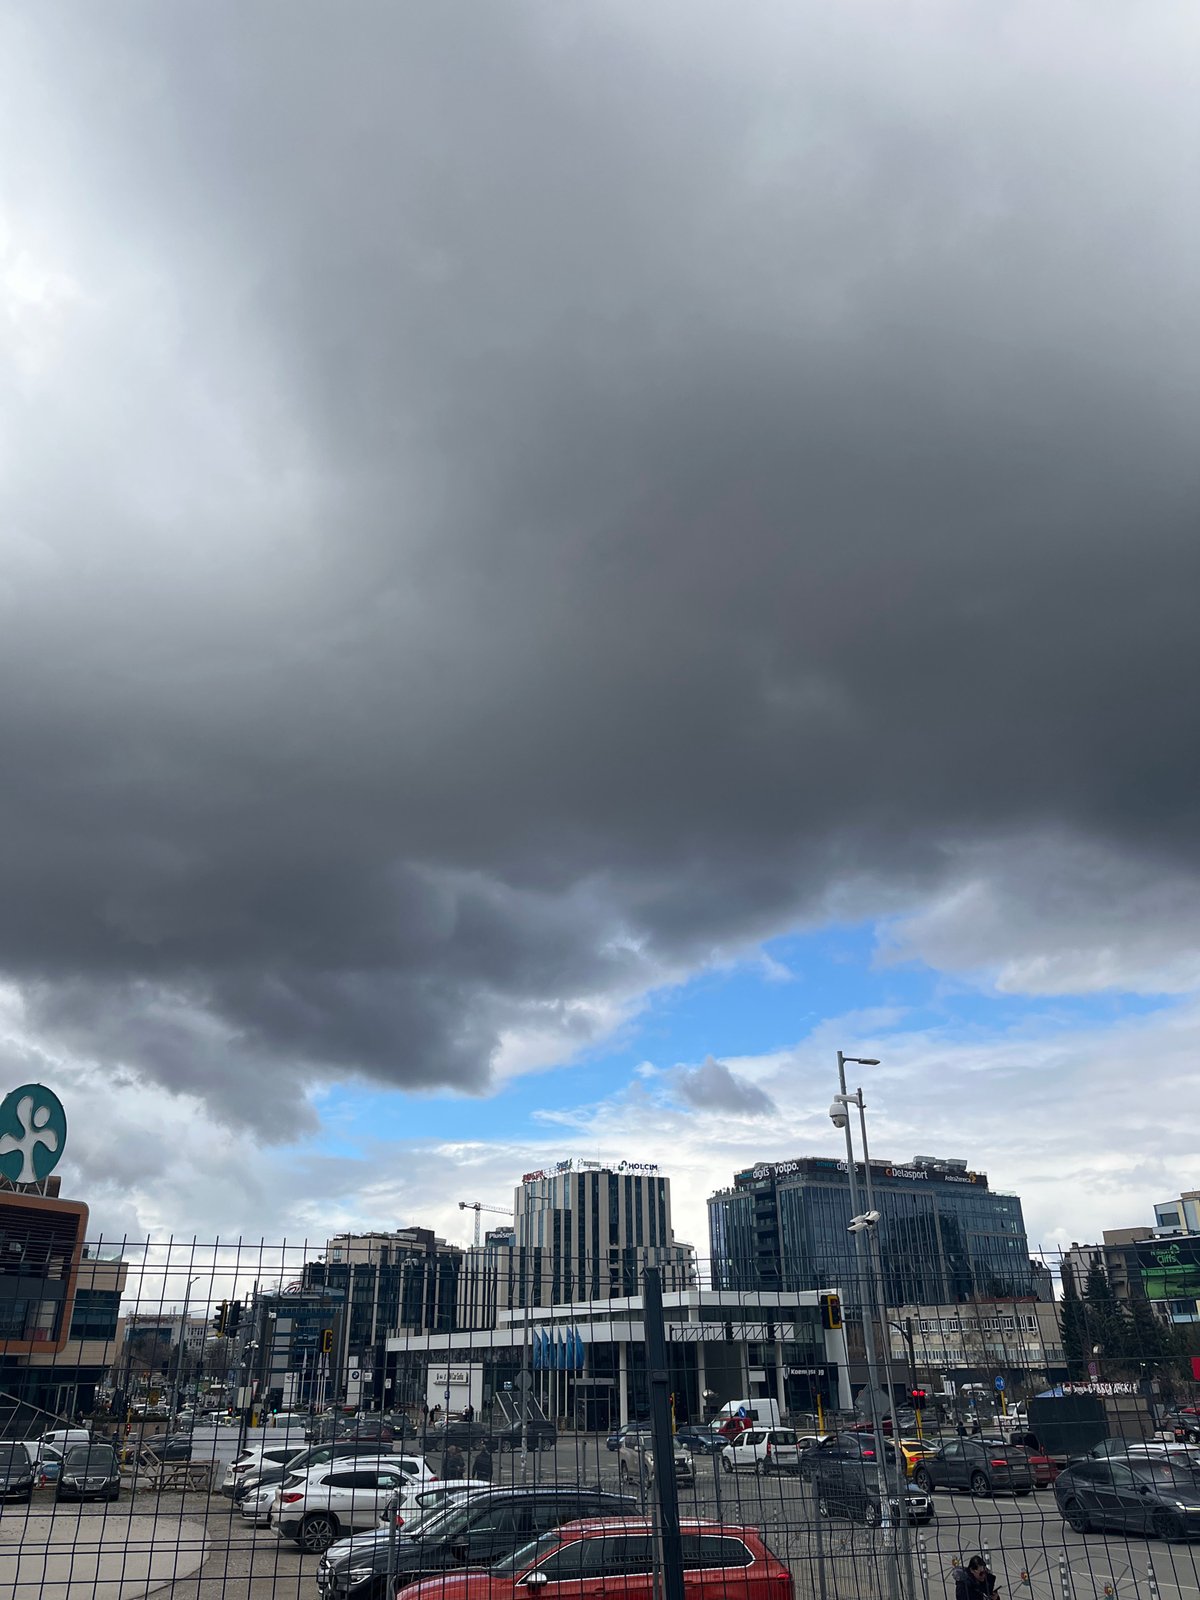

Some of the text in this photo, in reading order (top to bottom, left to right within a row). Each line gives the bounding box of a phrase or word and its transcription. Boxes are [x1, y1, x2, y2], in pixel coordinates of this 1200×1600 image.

[628, 1163, 658, 1171] HOLCIM
[836, 1160, 859, 1174] digs
[892, 1163, 928, 1180] Delasport
